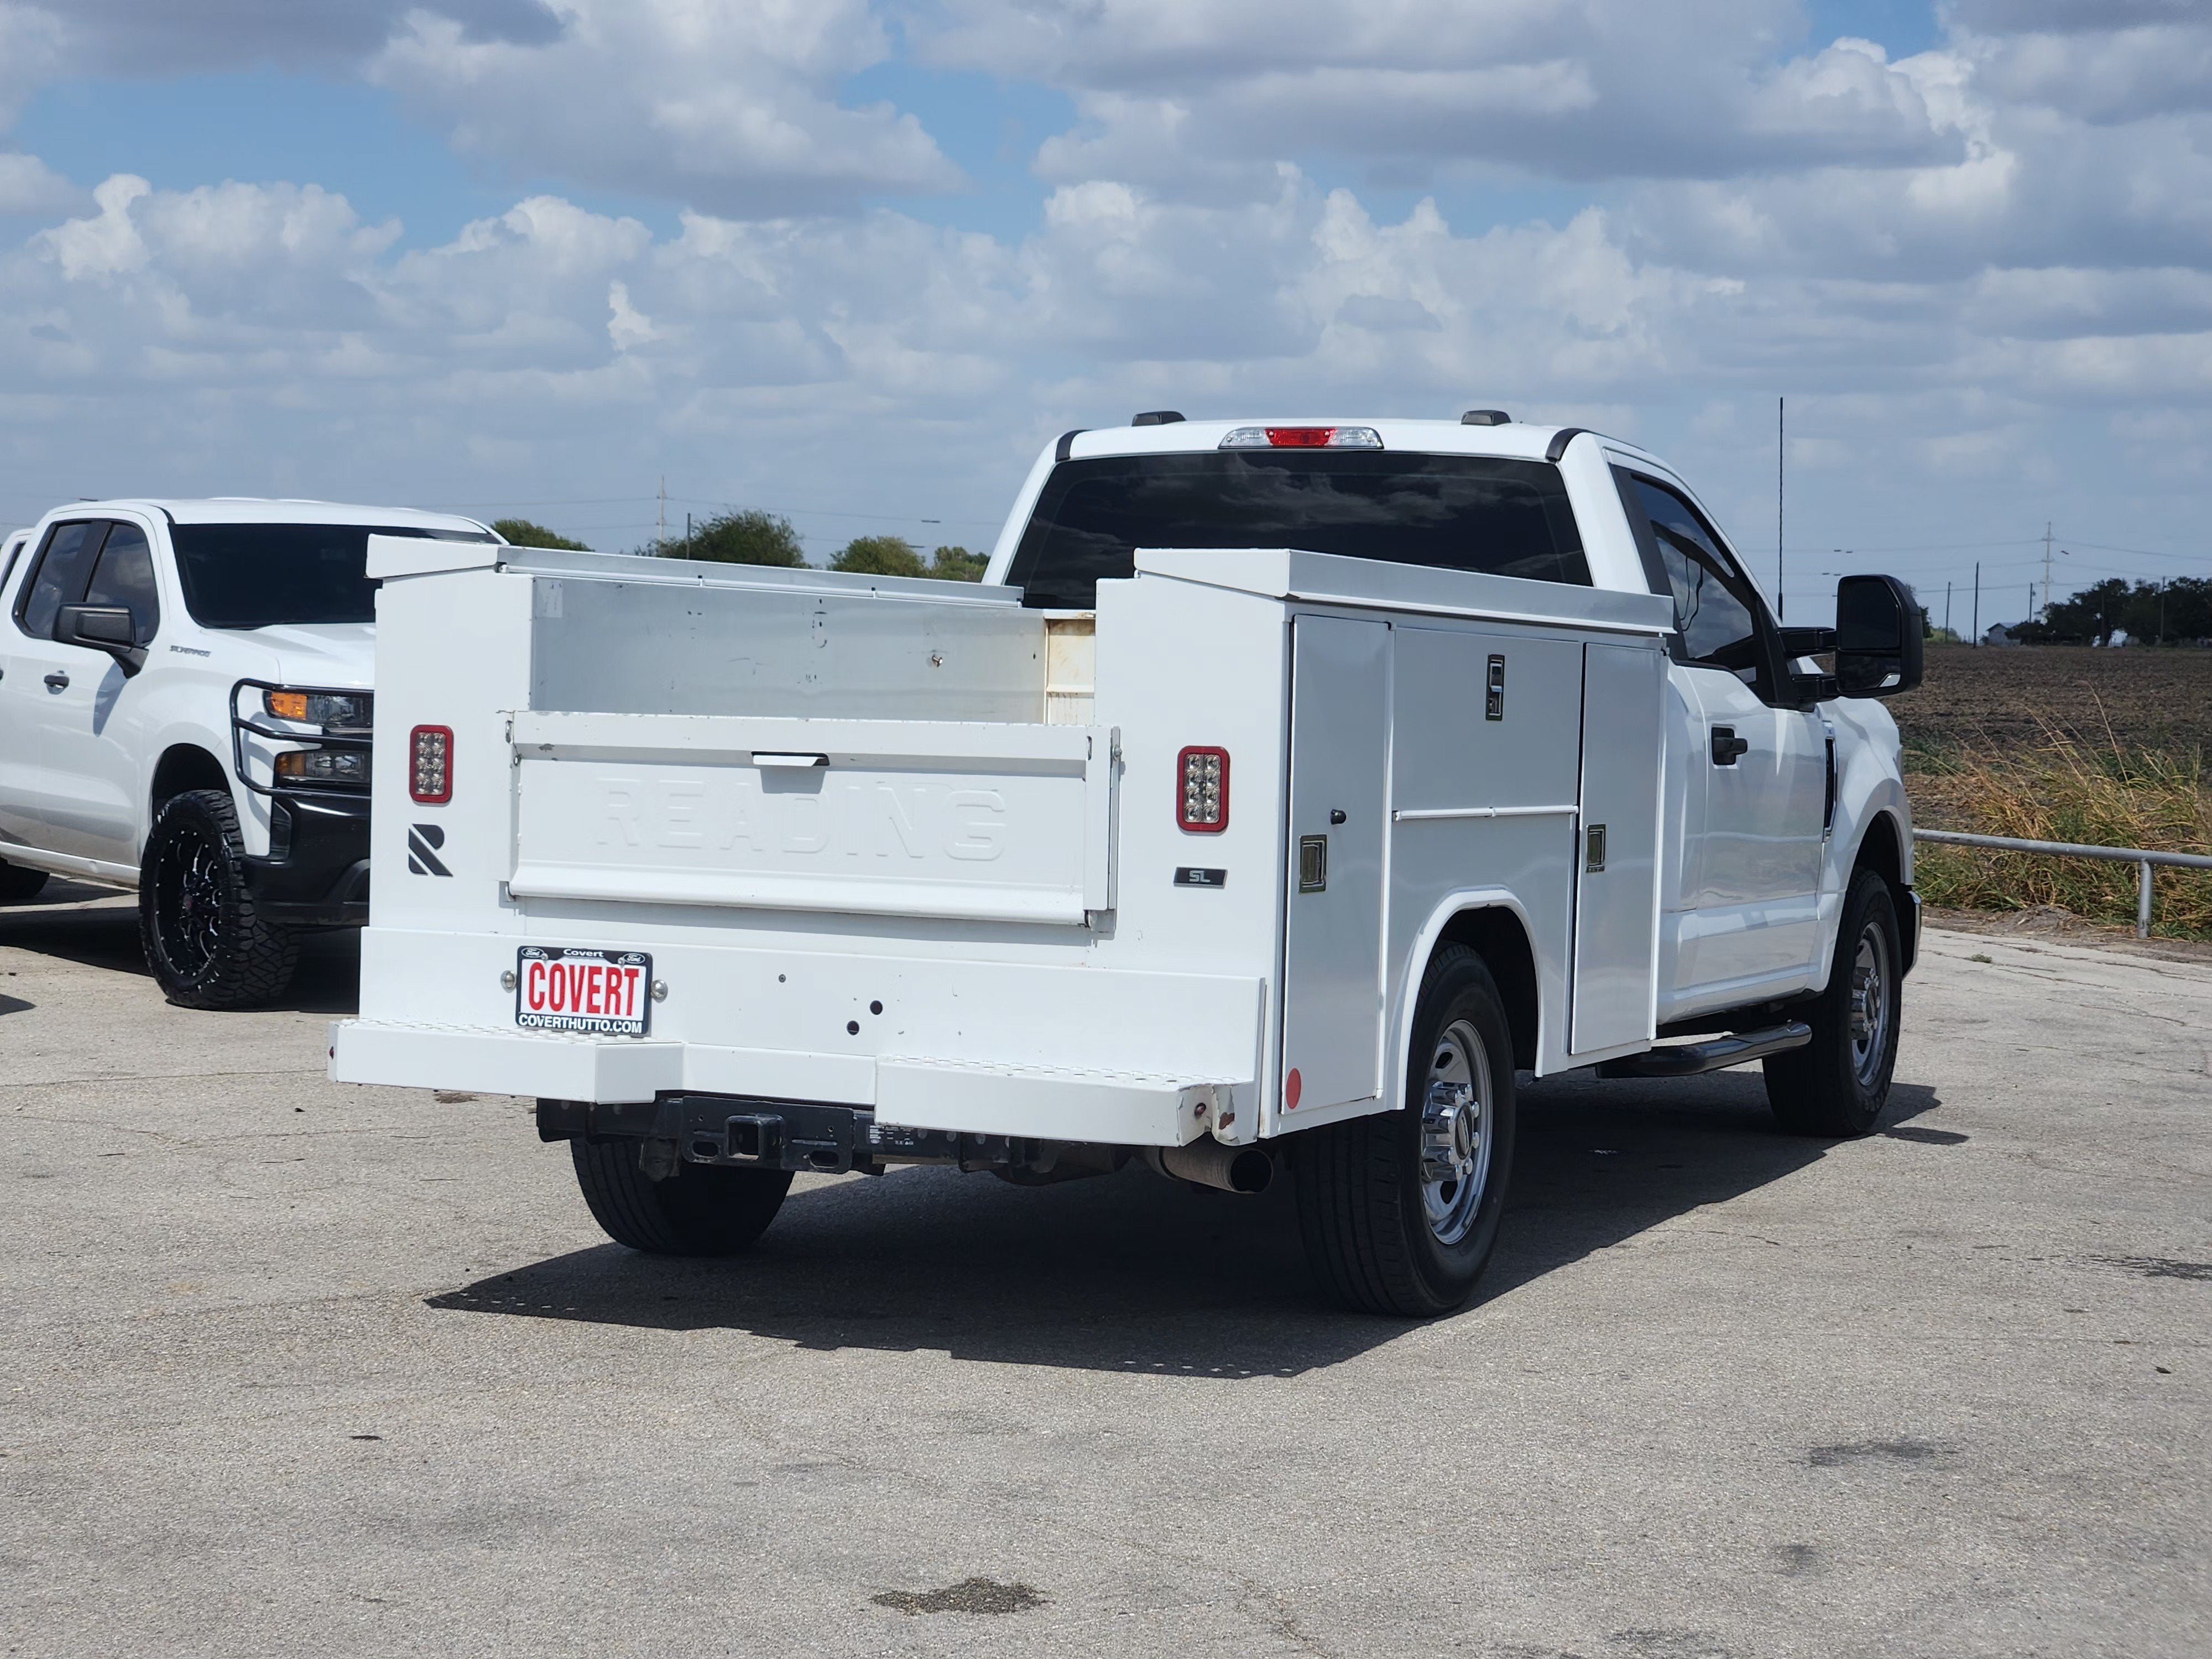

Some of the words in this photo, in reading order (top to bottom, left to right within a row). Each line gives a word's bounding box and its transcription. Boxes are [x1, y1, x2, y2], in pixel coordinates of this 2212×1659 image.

[594, 778, 1007, 861] READING
[1189, 870, 1211, 883] SL
[563, 948, 604, 958] Covert
[529, 962, 639, 1016] COVERT
[519, 1014, 642, 1034] COVERTHUTTO.COM
